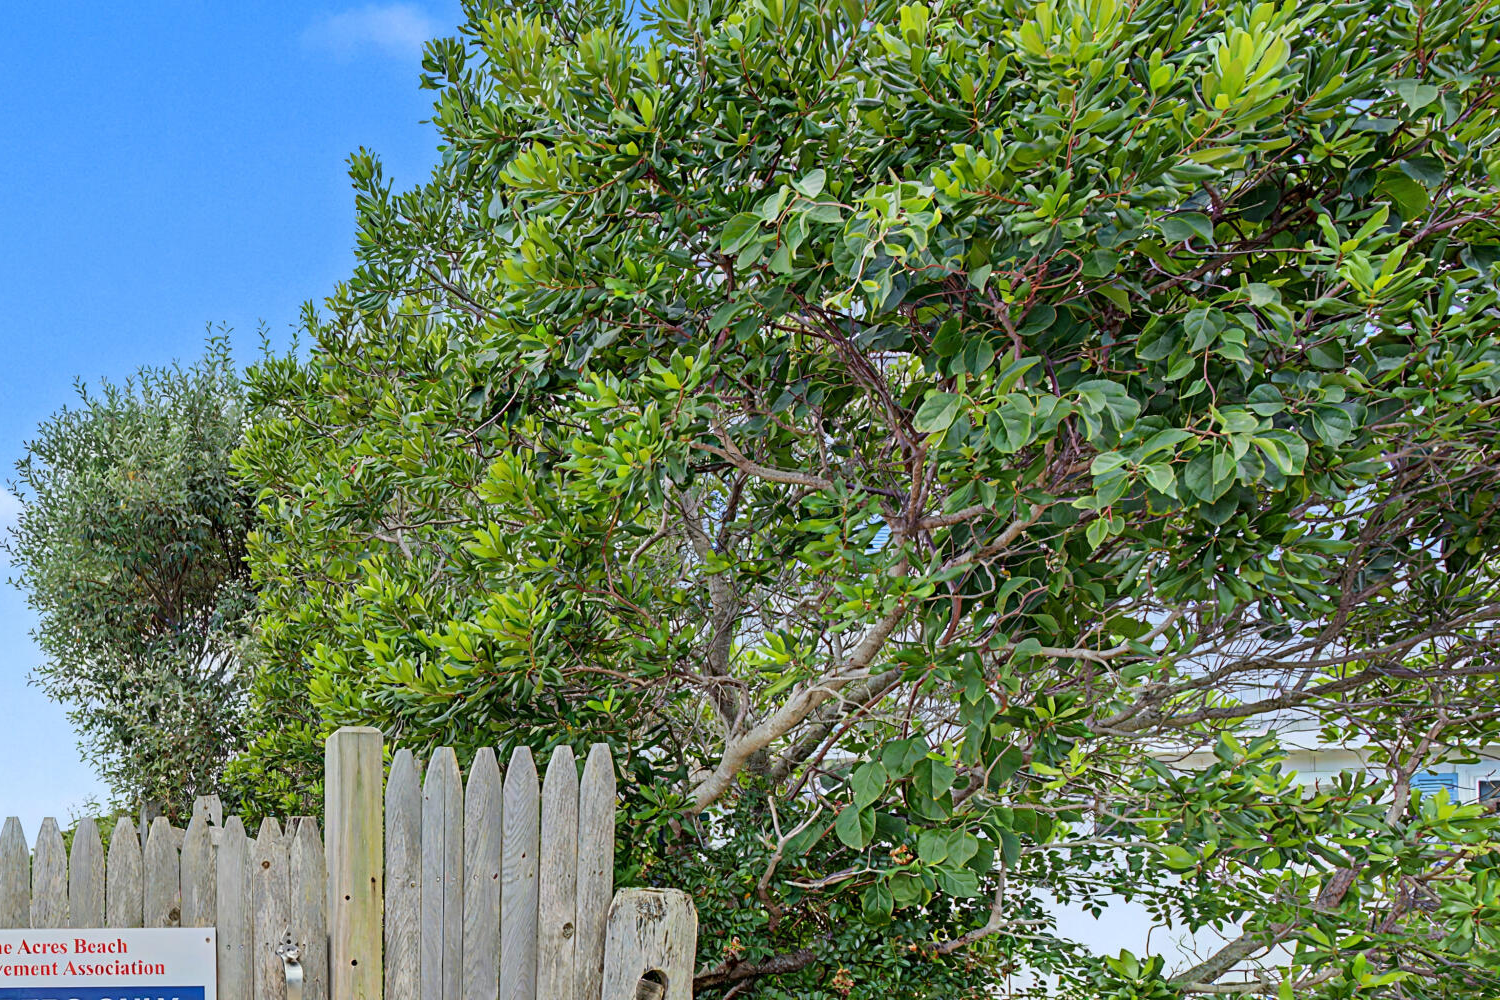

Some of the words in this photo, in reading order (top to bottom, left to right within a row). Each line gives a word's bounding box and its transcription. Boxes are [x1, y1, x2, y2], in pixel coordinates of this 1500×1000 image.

[17, 939, 68, 955] Acres
[74, 938, 127, 954] Beach
[62, 959, 165, 976] Association
